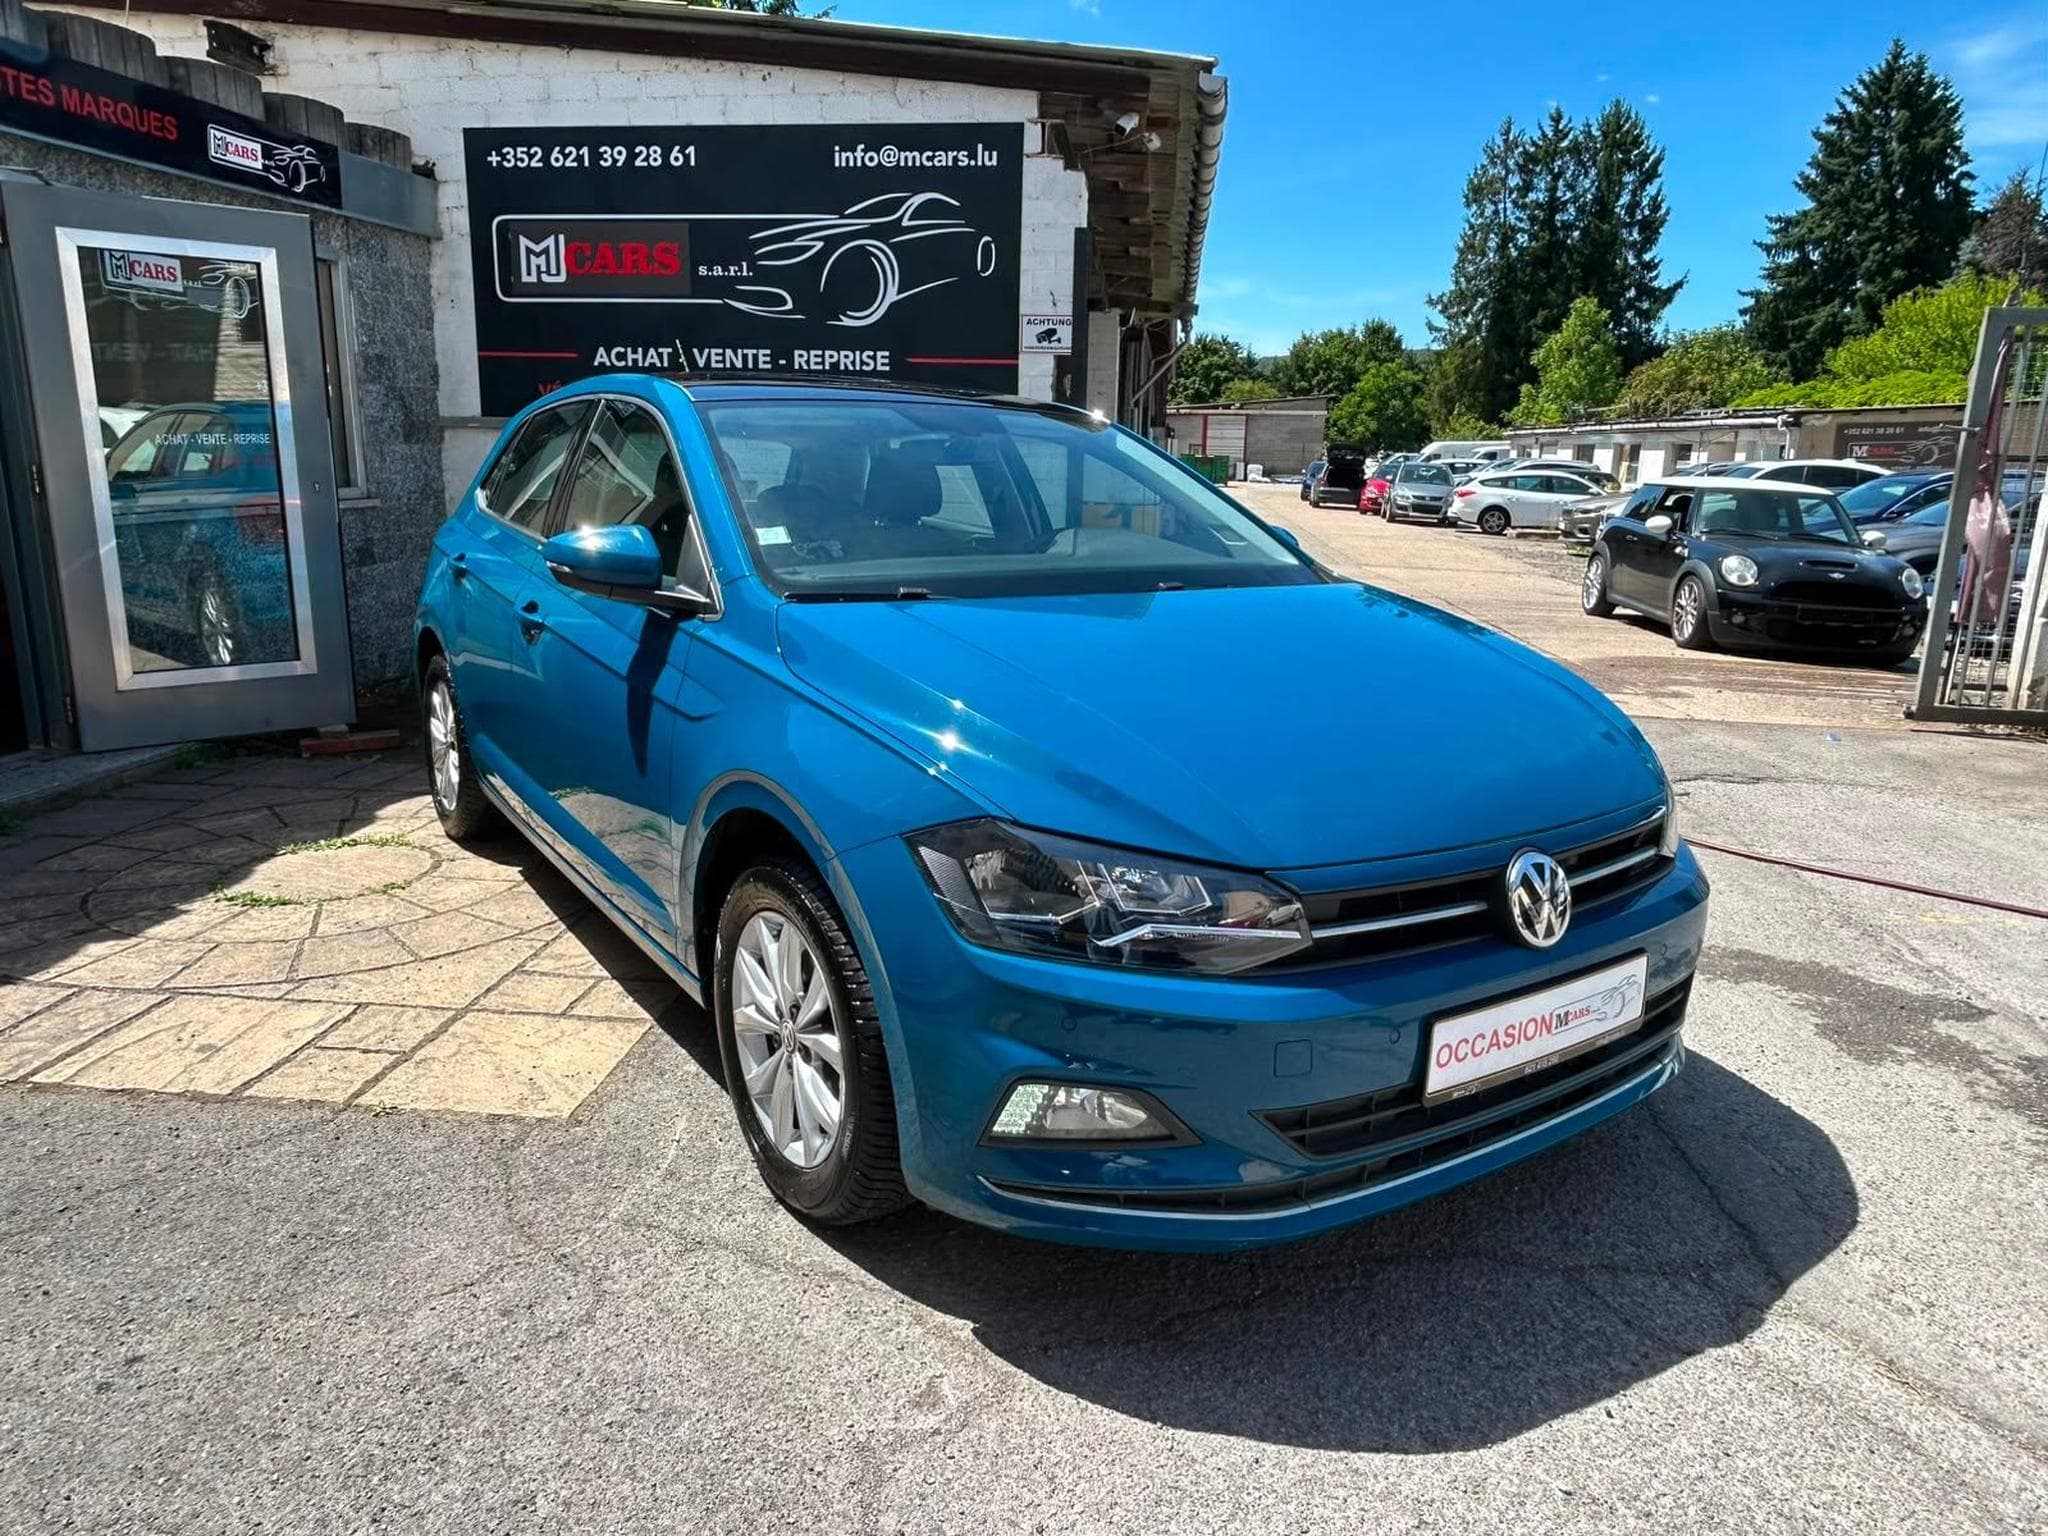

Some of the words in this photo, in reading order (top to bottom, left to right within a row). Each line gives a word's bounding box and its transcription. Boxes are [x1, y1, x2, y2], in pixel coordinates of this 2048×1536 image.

[60, 84, 179, 141] MARQUES
[487, 146, 543, 168] +352
[550, 145, 589, 168] 621
[599, 145, 627, 168] 39
[634, 145, 662, 167] 28
[669, 145, 695, 167] 61
[834, 143, 998, 168] info@mcars.lu
[1026, 318, 1072, 326] ACHTUNG
[593, 347, 673, 368] ACHAT
[693, 348, 772, 369] VENTE
[793, 350, 890, 371] REPRISE
[195, 433, 227, 446] VENTE
[233, 433, 271, 445] REPRISE
[1436, 1012, 1554, 1070] OCCASION
